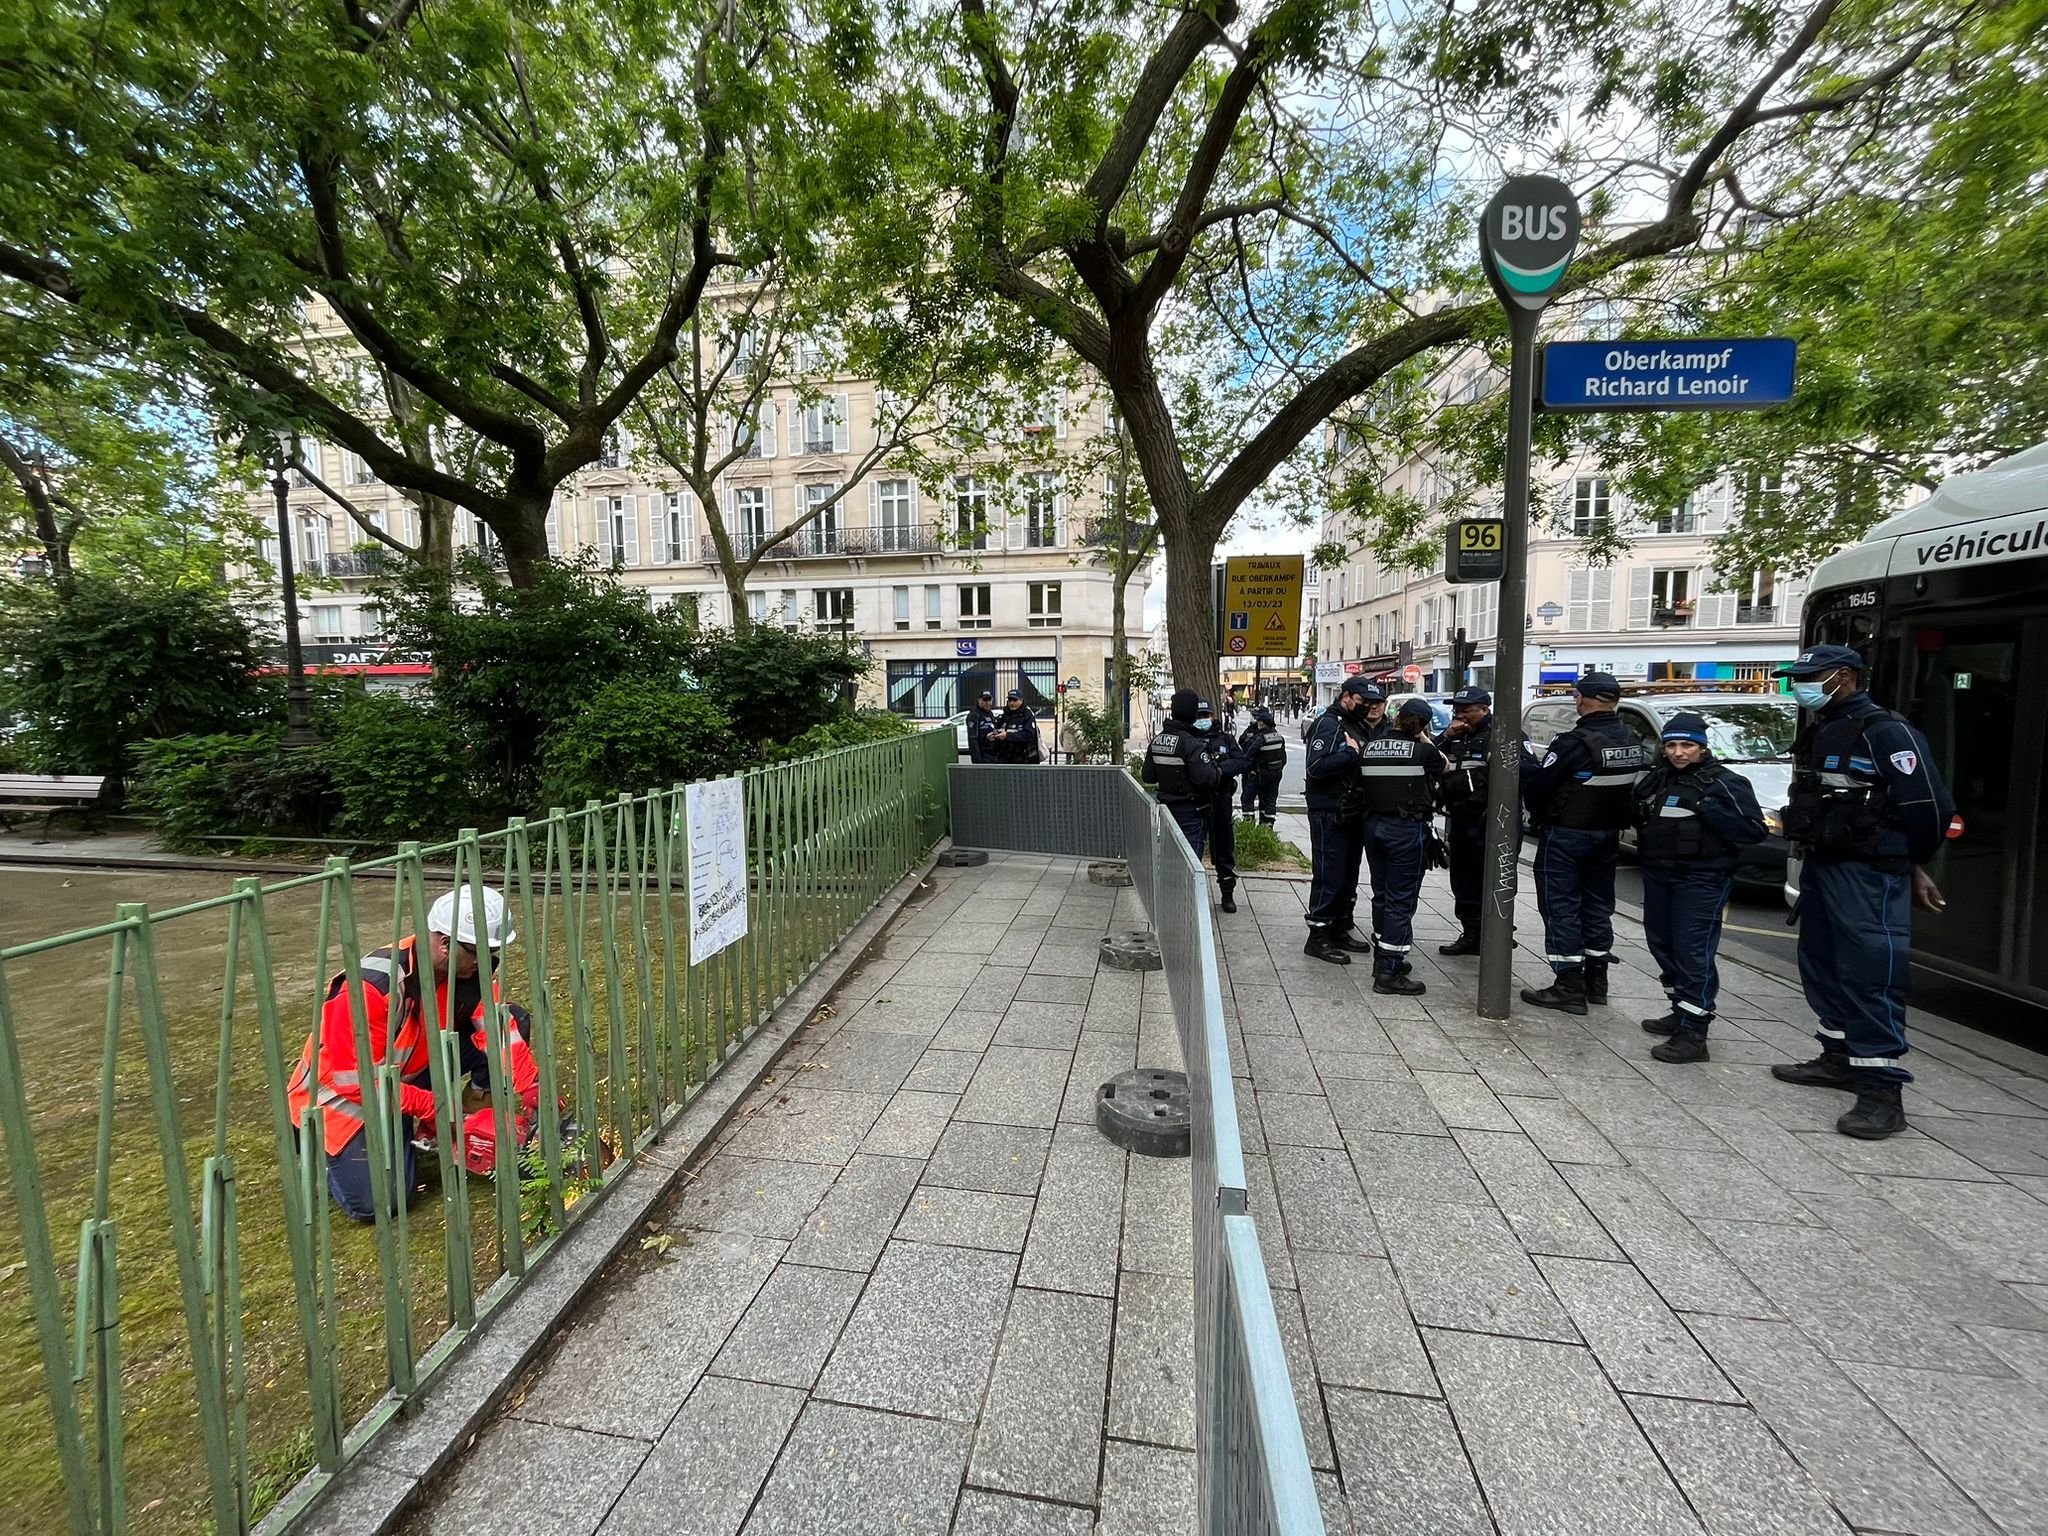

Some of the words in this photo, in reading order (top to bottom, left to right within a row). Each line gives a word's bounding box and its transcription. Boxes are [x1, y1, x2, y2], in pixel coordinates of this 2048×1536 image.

[1501, 205, 1568, 242] BUS
[1604, 348, 1733, 372] Oberkampf
[1585, 375, 1669, 397] Richard
[1677, 374, 1749, 395] Lenoir
[1465, 526, 1496, 548] 96
[1916, 521, 2048, 566] véhicul
[1249, 574, 1296, 582] OBERKAMPF
[1240, 586, 1244, 595] À
[1247, 587, 1274, 595] PARTIR
[1276, 587, 1287, 595] DU
[1243, 600, 1283, 608] 13/03/23
[1849, 591, 1876, 608] 1645
[958, 641, 974, 649] LCL
[333, 652, 385, 663] DAFY
[1152, 735, 1177, 746] POLICE
[1368, 741, 1410, 750] POLICE
[1605, 748, 1642, 760] POLICE
